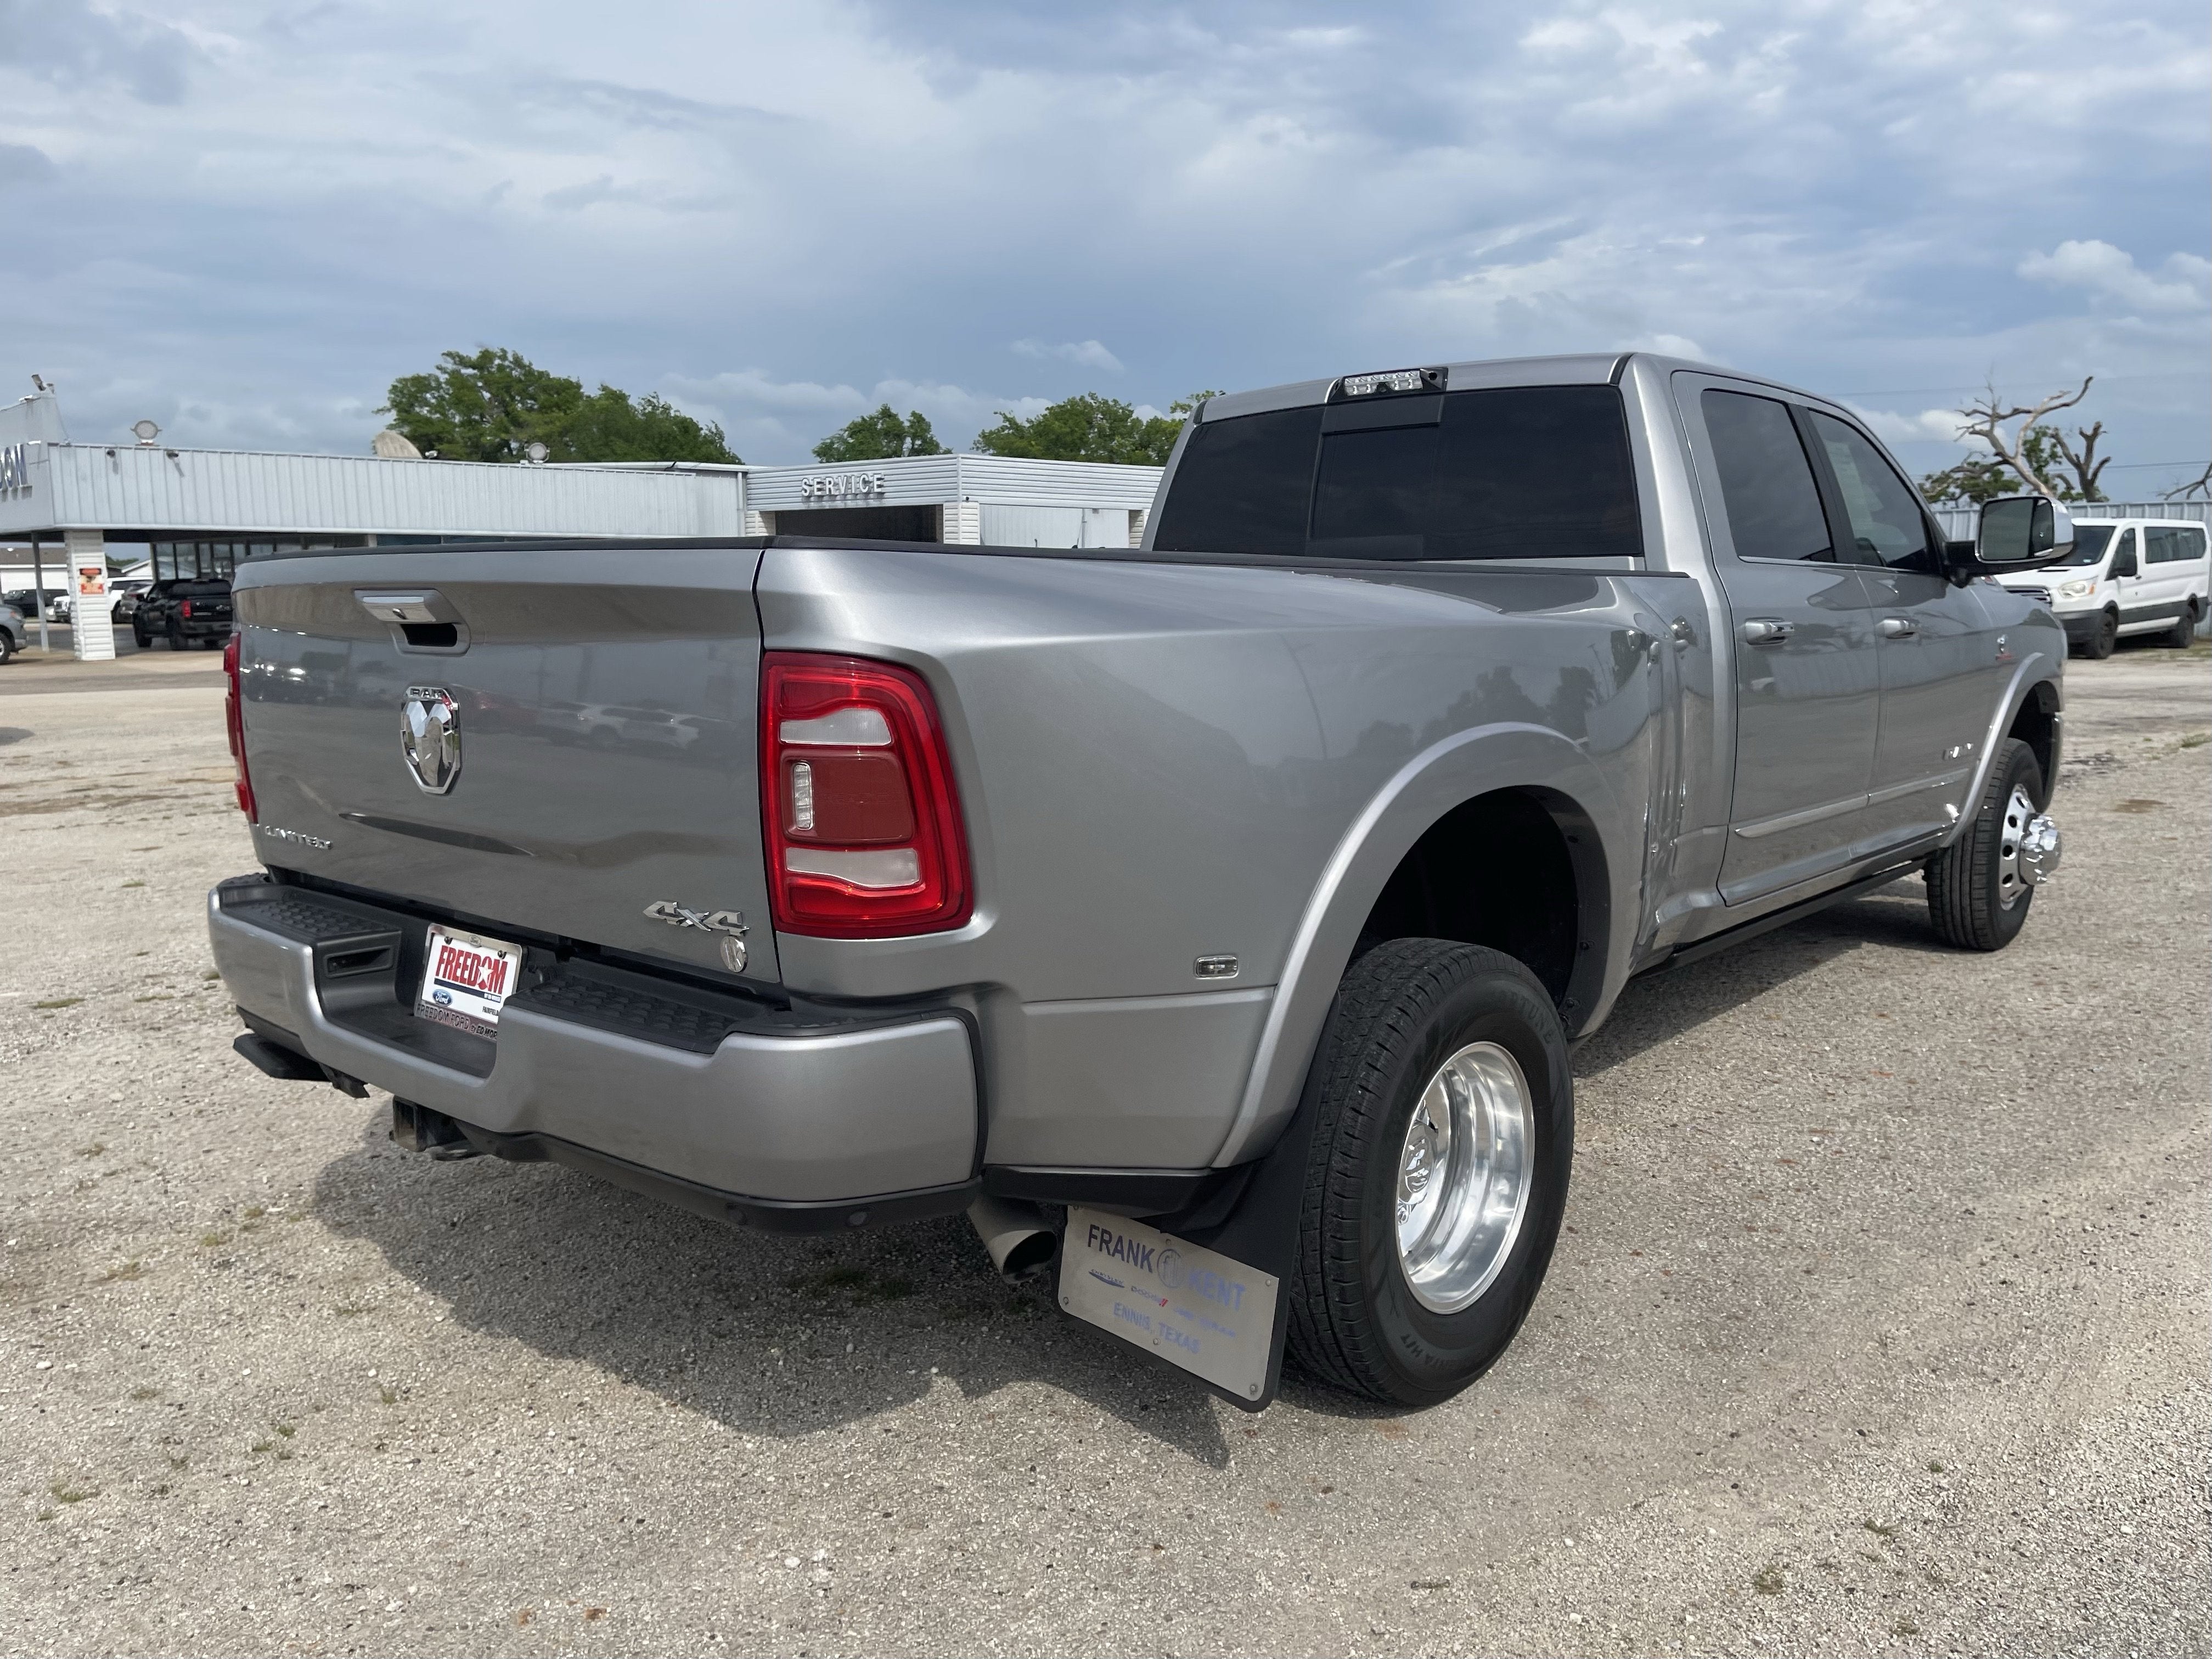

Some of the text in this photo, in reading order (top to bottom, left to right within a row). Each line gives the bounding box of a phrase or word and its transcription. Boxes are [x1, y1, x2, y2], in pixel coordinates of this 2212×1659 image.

[802, 474, 882, 496] SERVICE
[436, 945, 508, 994] FREEDOM
[416, 1002, 449, 1022] FREEDOM
[451, 1012, 470, 1030] FORD
[484, 1027, 497, 1039] MOR
[1088, 1224, 1155, 1273] FRANK
[1189, 1267, 1246, 1311] KENT
[1159, 1322, 1201, 1354] TEXAS
